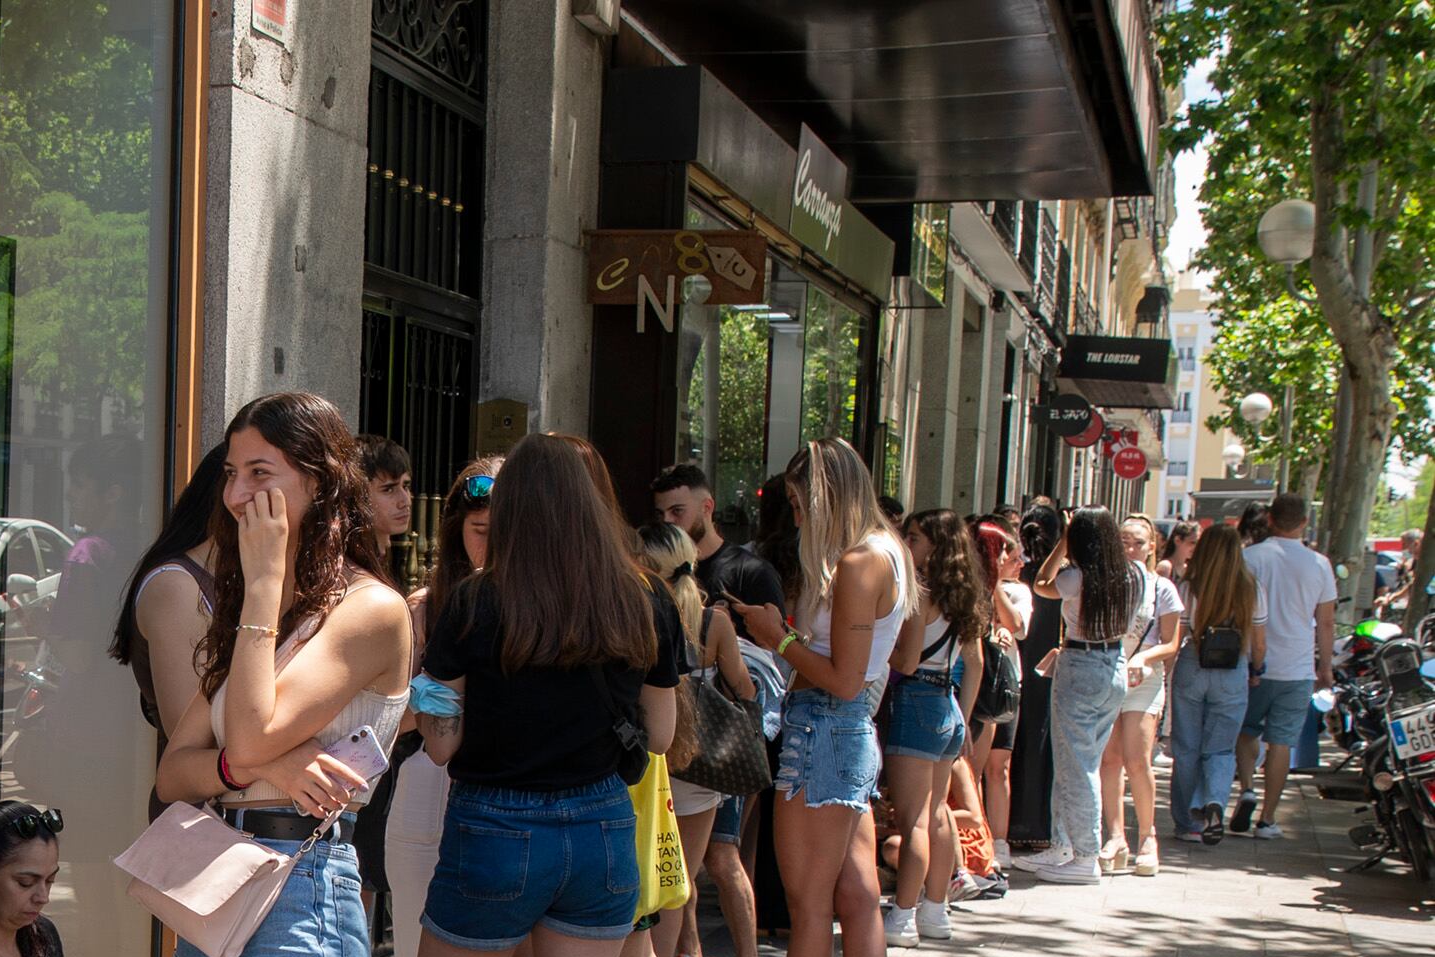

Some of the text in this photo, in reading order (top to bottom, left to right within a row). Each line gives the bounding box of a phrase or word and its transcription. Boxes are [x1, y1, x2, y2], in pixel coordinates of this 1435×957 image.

[794, 148, 842, 251] Carranza
[1086, 351, 1102, 363] THE
[656, 861, 673, 874] NO
